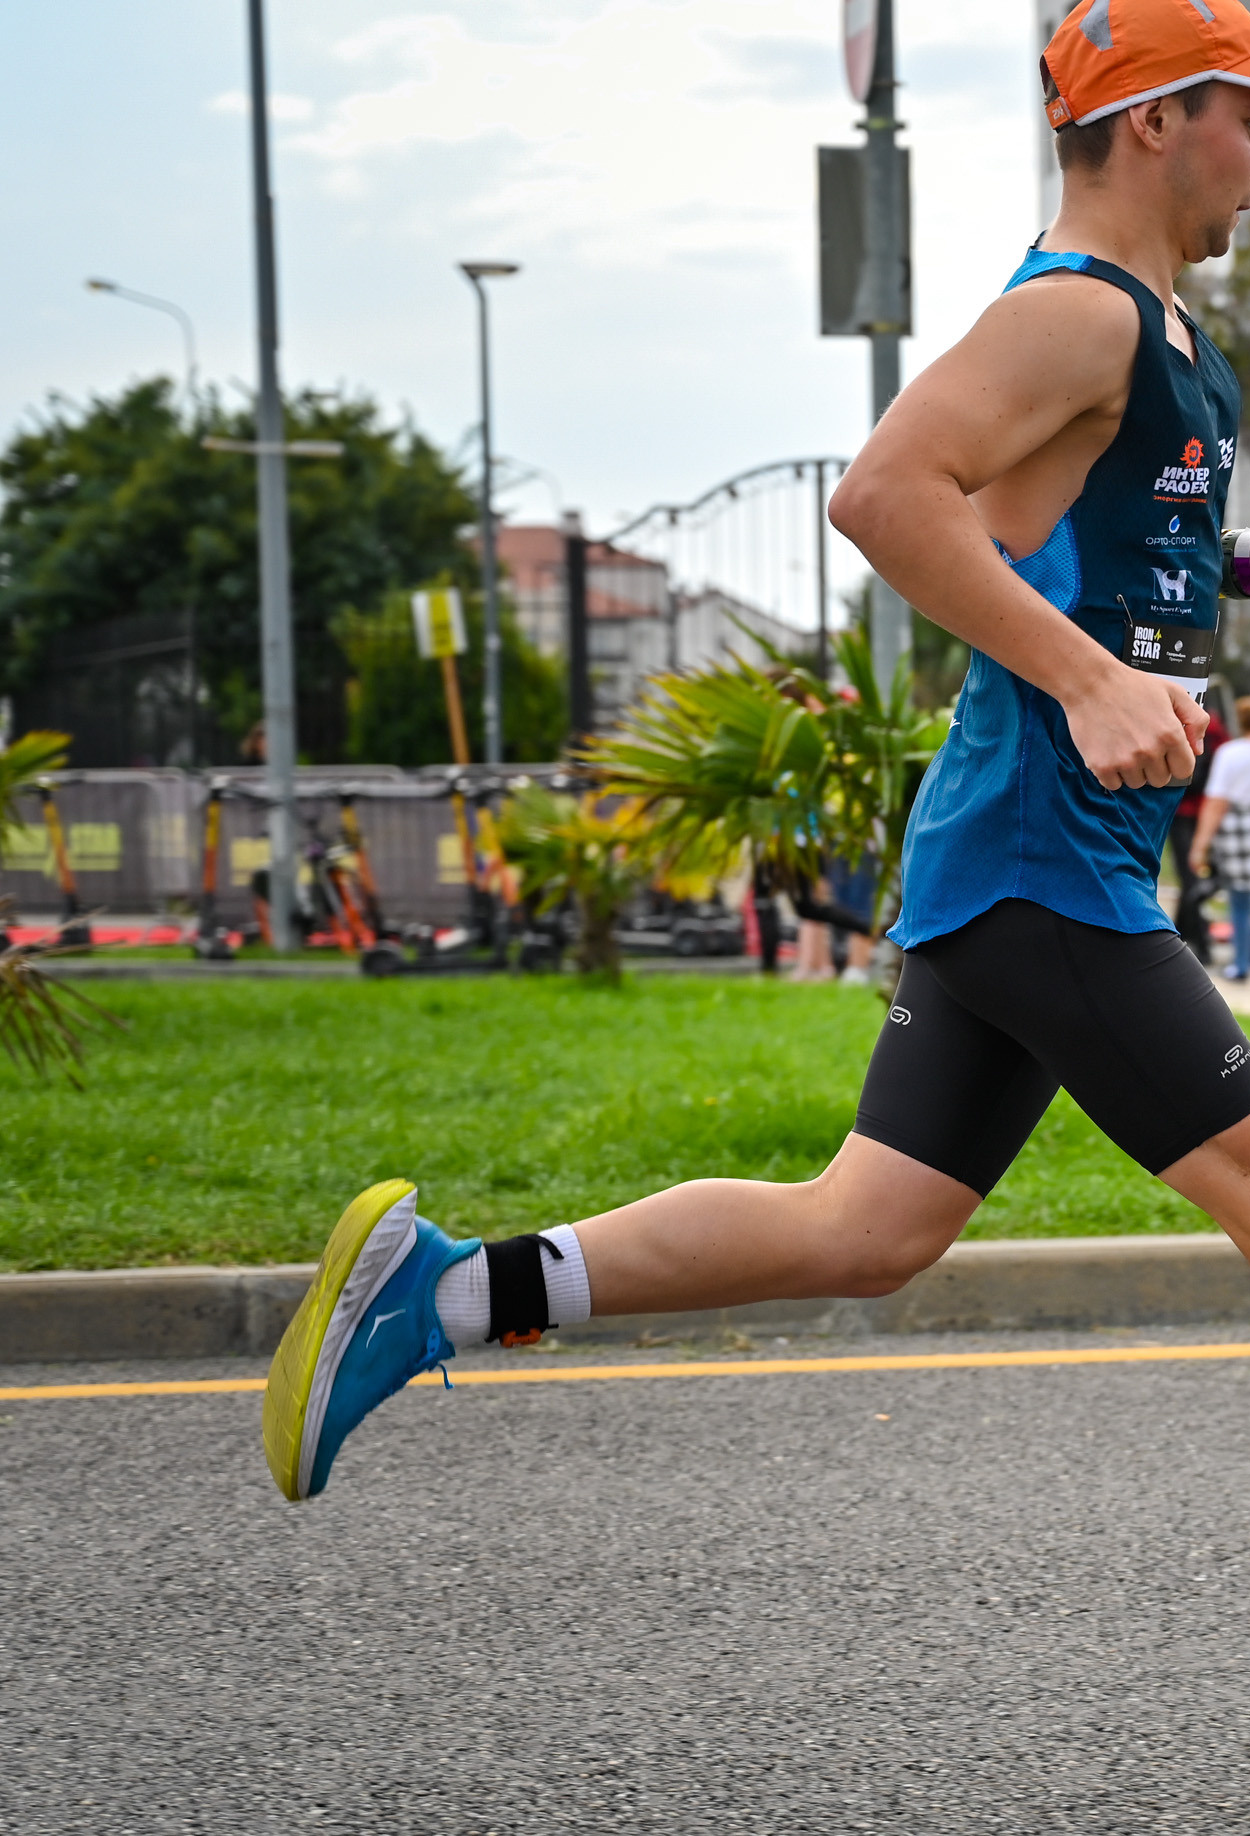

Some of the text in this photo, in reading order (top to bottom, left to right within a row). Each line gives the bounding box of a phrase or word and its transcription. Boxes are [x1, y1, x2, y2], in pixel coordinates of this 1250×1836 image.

[1162, 466, 1210, 481] ИНТЕР
[1145, 536, 1196, 546] ОРТО-СПОРТ
[1134, 626, 1155, 641] IRON
[1132, 640, 1161, 660] STAR
